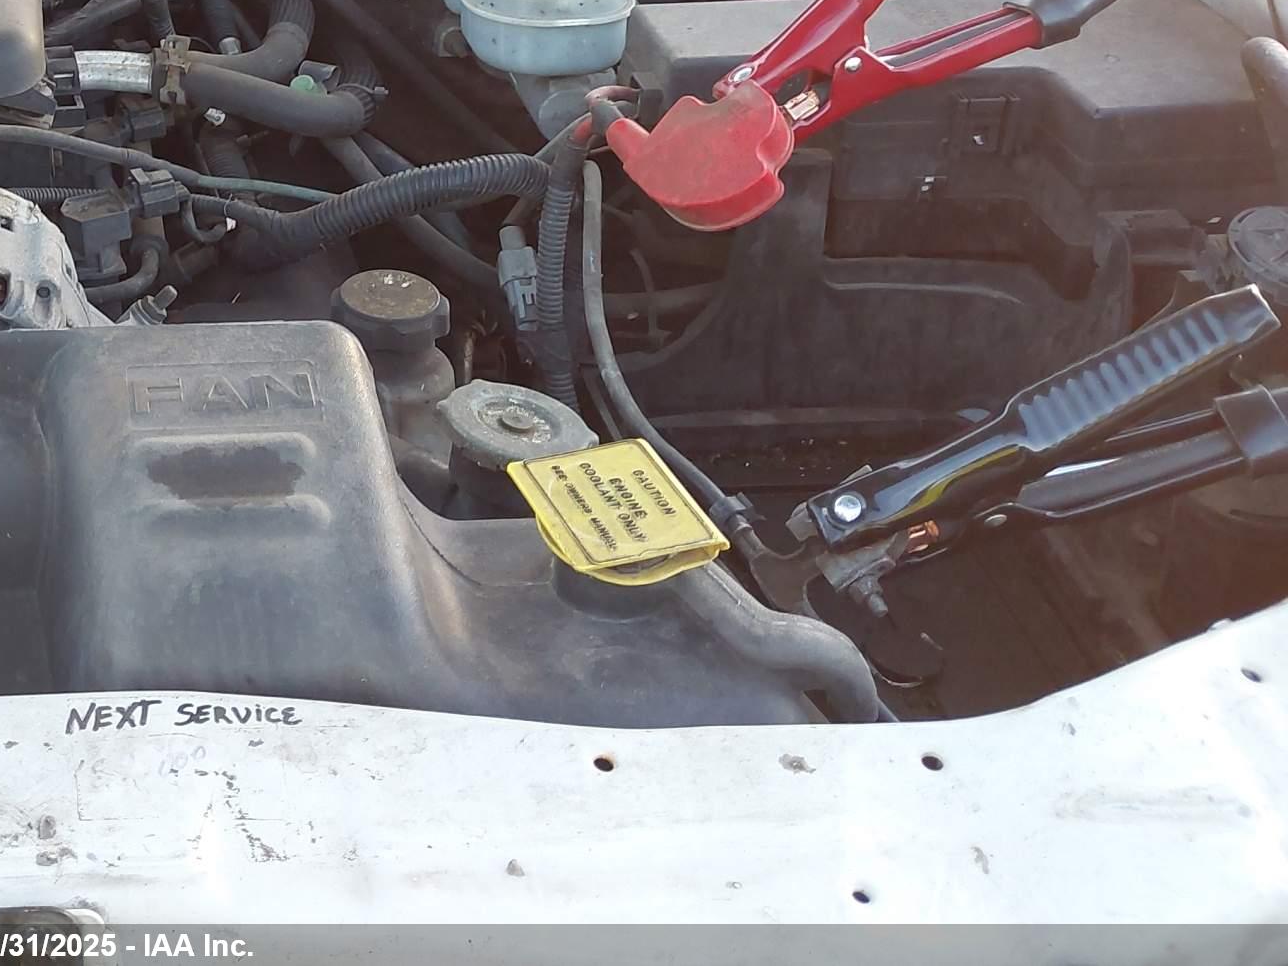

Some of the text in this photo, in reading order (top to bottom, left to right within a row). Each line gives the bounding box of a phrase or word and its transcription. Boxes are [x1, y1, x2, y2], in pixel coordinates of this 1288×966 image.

[132, 372, 316, 413] FAN
[552, 465, 567, 482] SEE
[590, 516, 617, 550] MANUAL
[579, 462, 647, 542] COOLANT ONLY
[609, 477, 648, 519] ENGINE
[632, 469, 677, 515] CAUTION
[65, 699, 162, 734] NEXT
